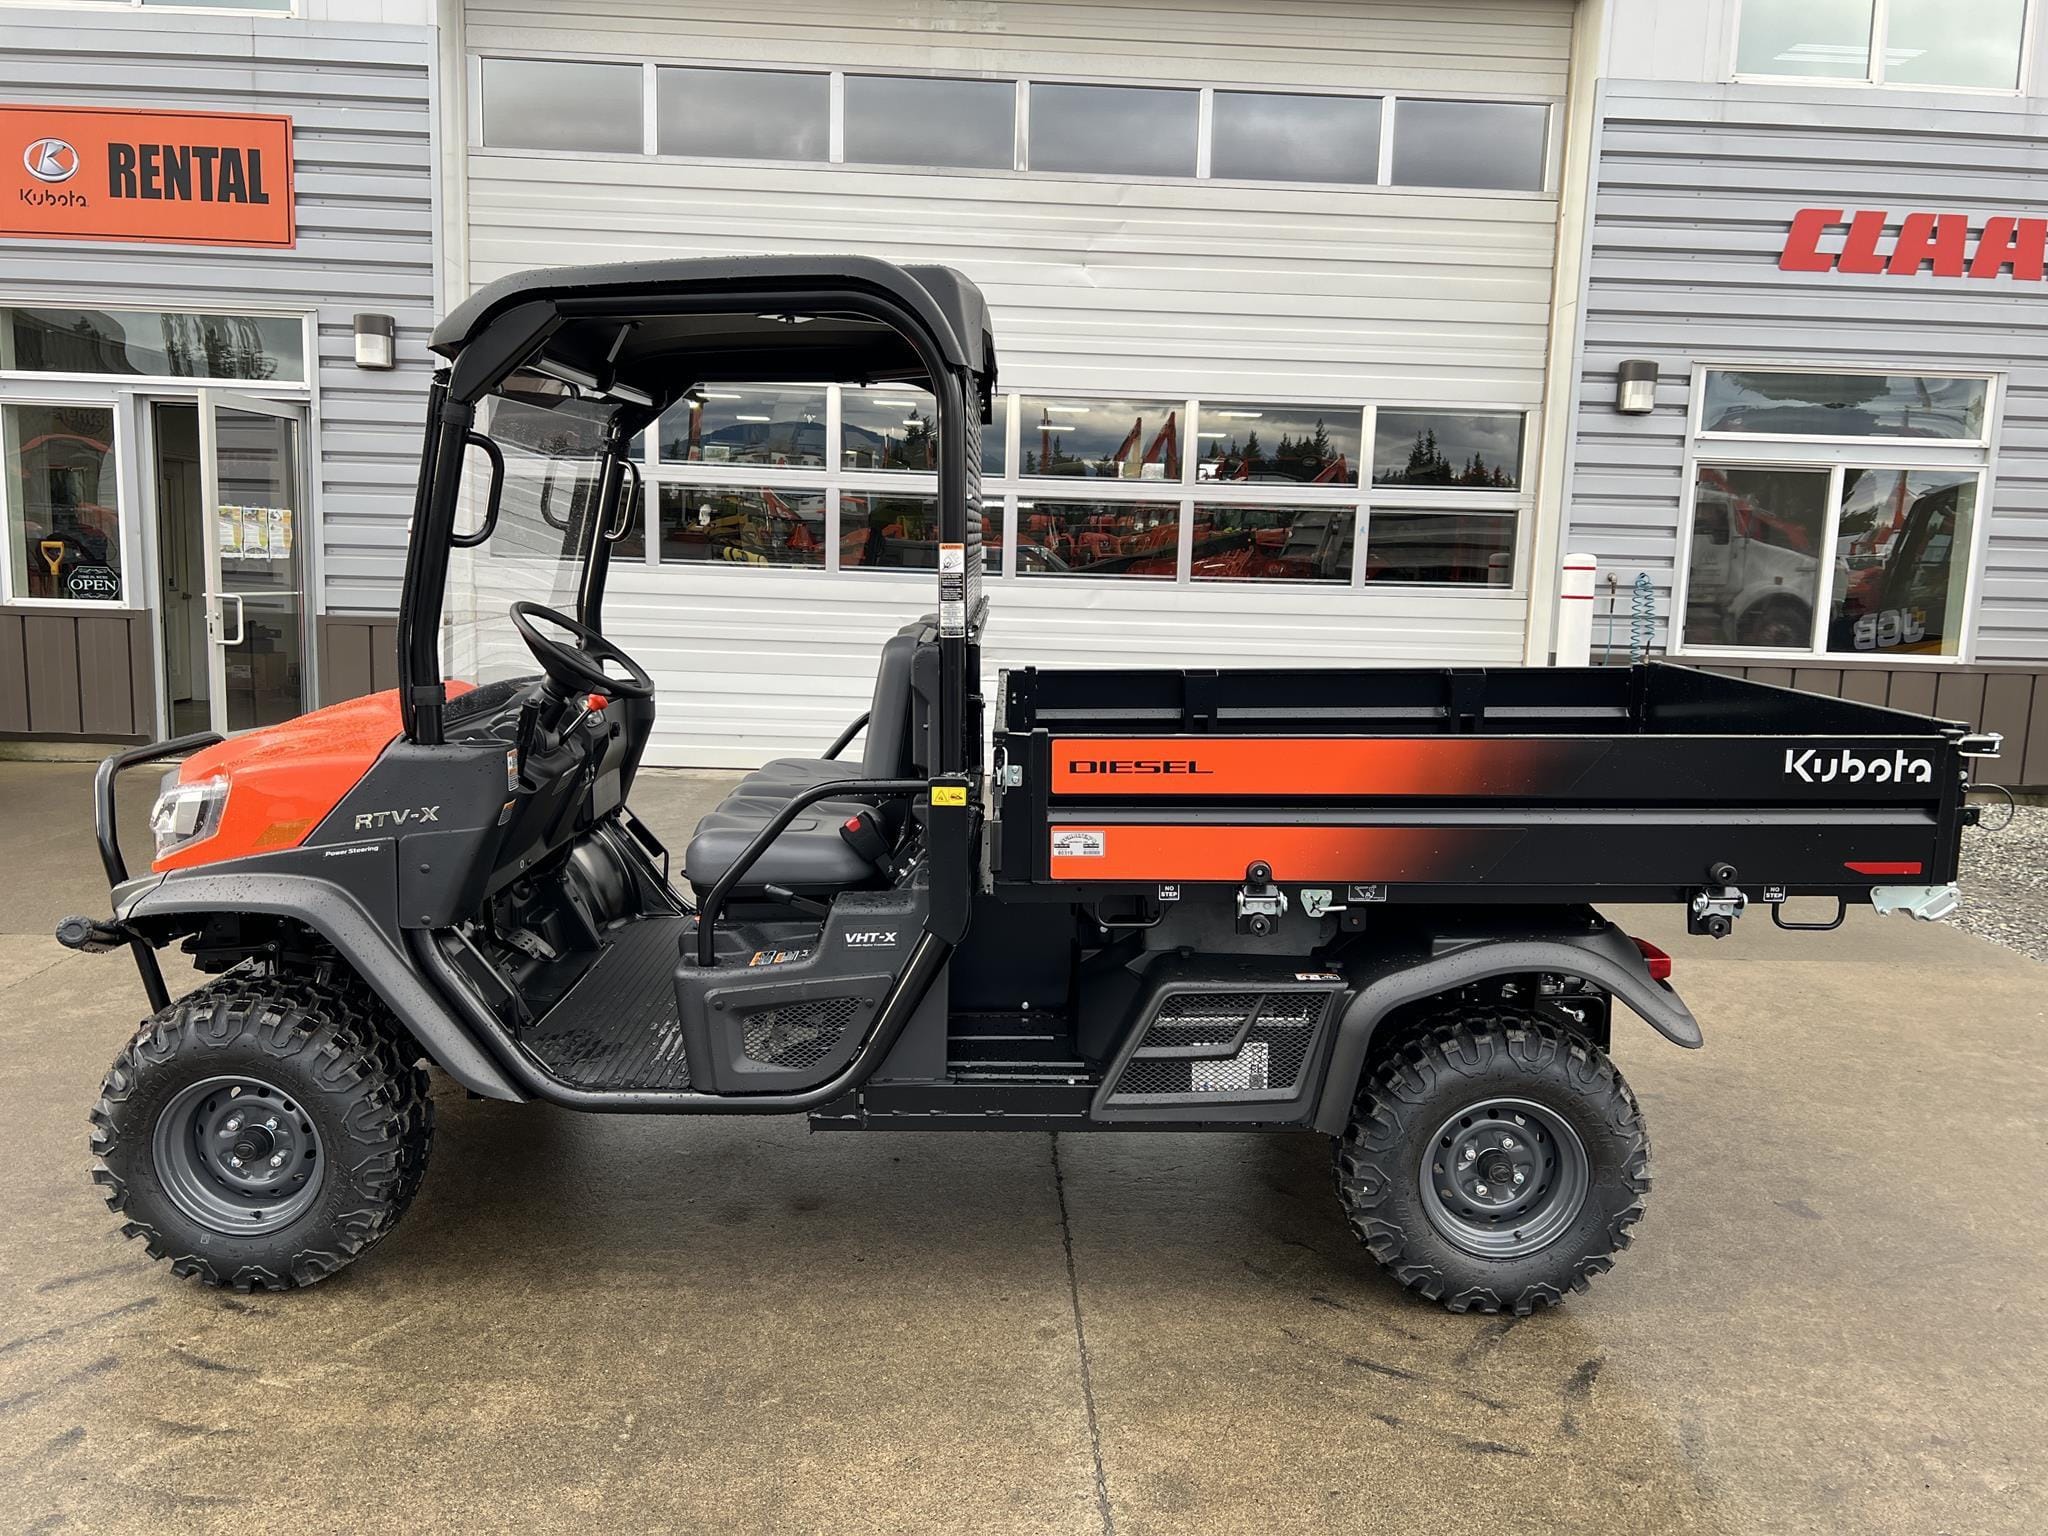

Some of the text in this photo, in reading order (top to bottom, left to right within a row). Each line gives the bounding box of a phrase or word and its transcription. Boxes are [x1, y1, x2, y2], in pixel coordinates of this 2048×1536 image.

[108, 142, 270, 205] RENTAL
[20, 188, 88, 207] Kubota
[1778, 208, 2048, 281] CLAA
[70, 579, 117, 590] OPEN
[1069, 761, 1214, 774] DIESEL
[1785, 750, 1931, 783] Kubota
[355, 805, 440, 831] RTV-X
[348, 845, 380, 854] Steering
[845, 932, 897, 942] VHT-X
